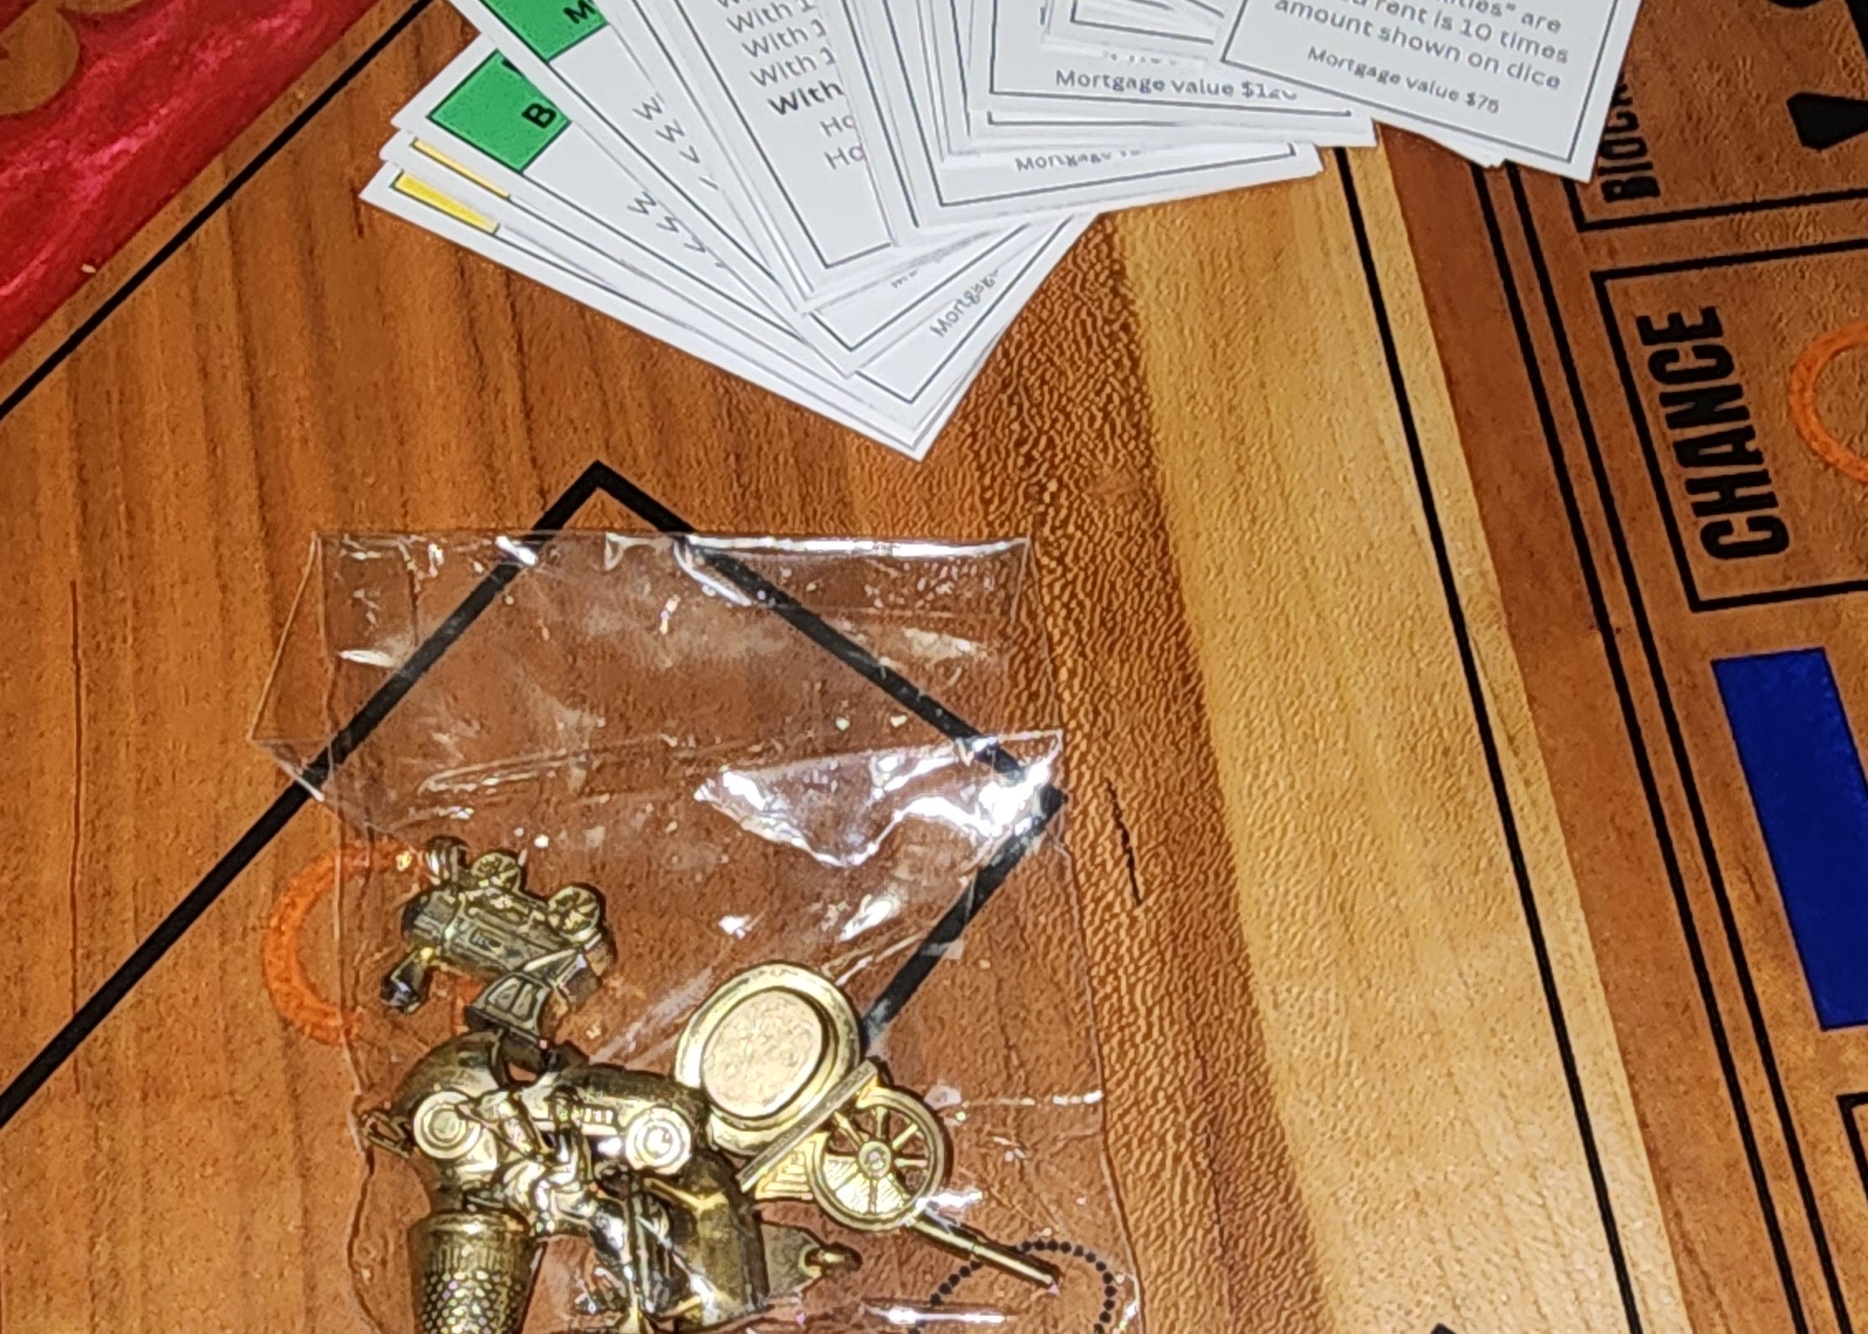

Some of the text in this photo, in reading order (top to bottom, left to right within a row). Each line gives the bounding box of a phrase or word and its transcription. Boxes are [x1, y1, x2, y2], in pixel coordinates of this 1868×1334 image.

[727, 2, 794, 34] With
[1520, 9, 1561, 34] are
[742, 27, 809, 58] With
[1433, 9, 1454, 32] is
[1459, 17, 1492, 42] 10
[1500, 26, 1568, 65] times
[750, 55, 818, 87] With
[1379, 23, 1460, 64] shown
[1468, 51, 1500, 74] on
[1507, 60, 1560, 90] dice
[1054, 68, 1166, 95] Mortgage
[1170, 77, 1235, 98] value
[1307, 45, 1500, 114] Mortgage value $75
[767, 80, 845, 116] With
[1638, 306, 1791, 561] CHANCE
